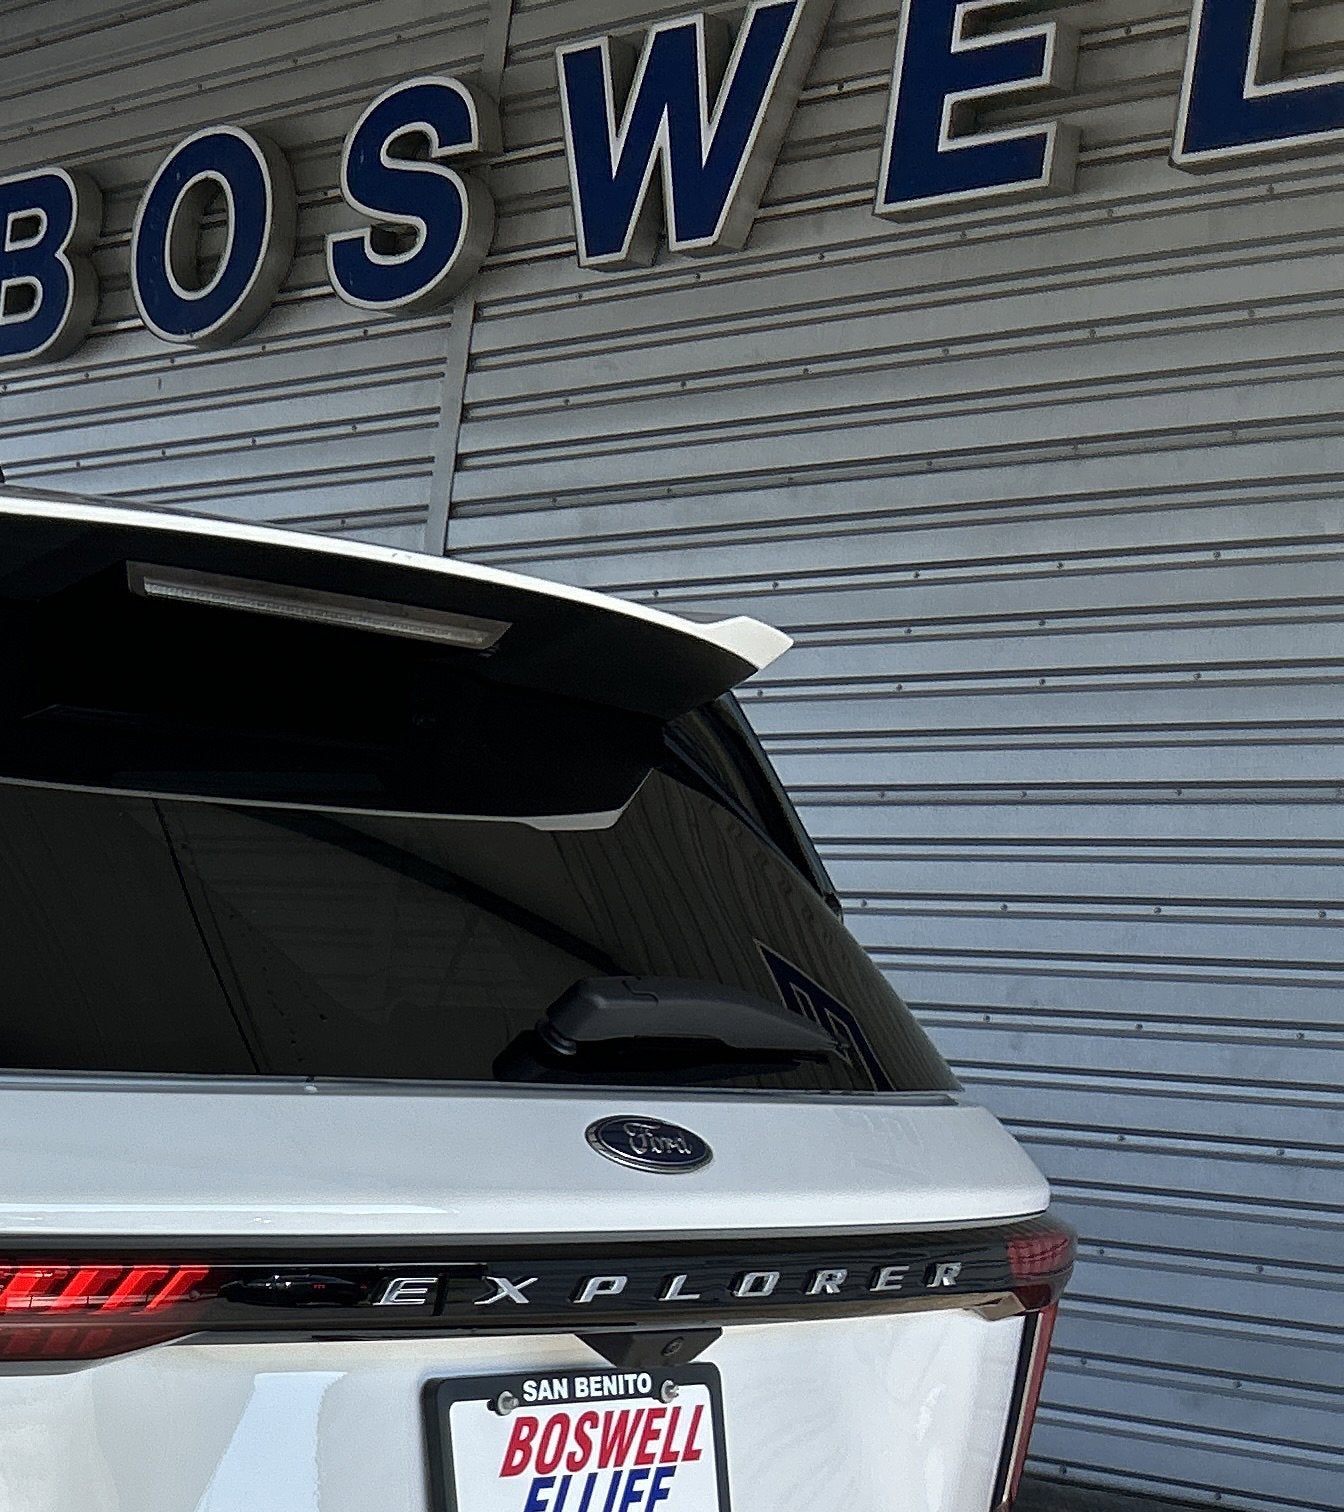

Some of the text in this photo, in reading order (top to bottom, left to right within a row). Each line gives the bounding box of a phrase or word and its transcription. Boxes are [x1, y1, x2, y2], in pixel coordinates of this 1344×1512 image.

[623, 1122, 692, 1155] Ford
[373, 1262, 962, 1305] EXPLORER
[522, 1372, 652, 1402] SAN BENITO
[499, 1404, 705, 1477] BOSWELL
